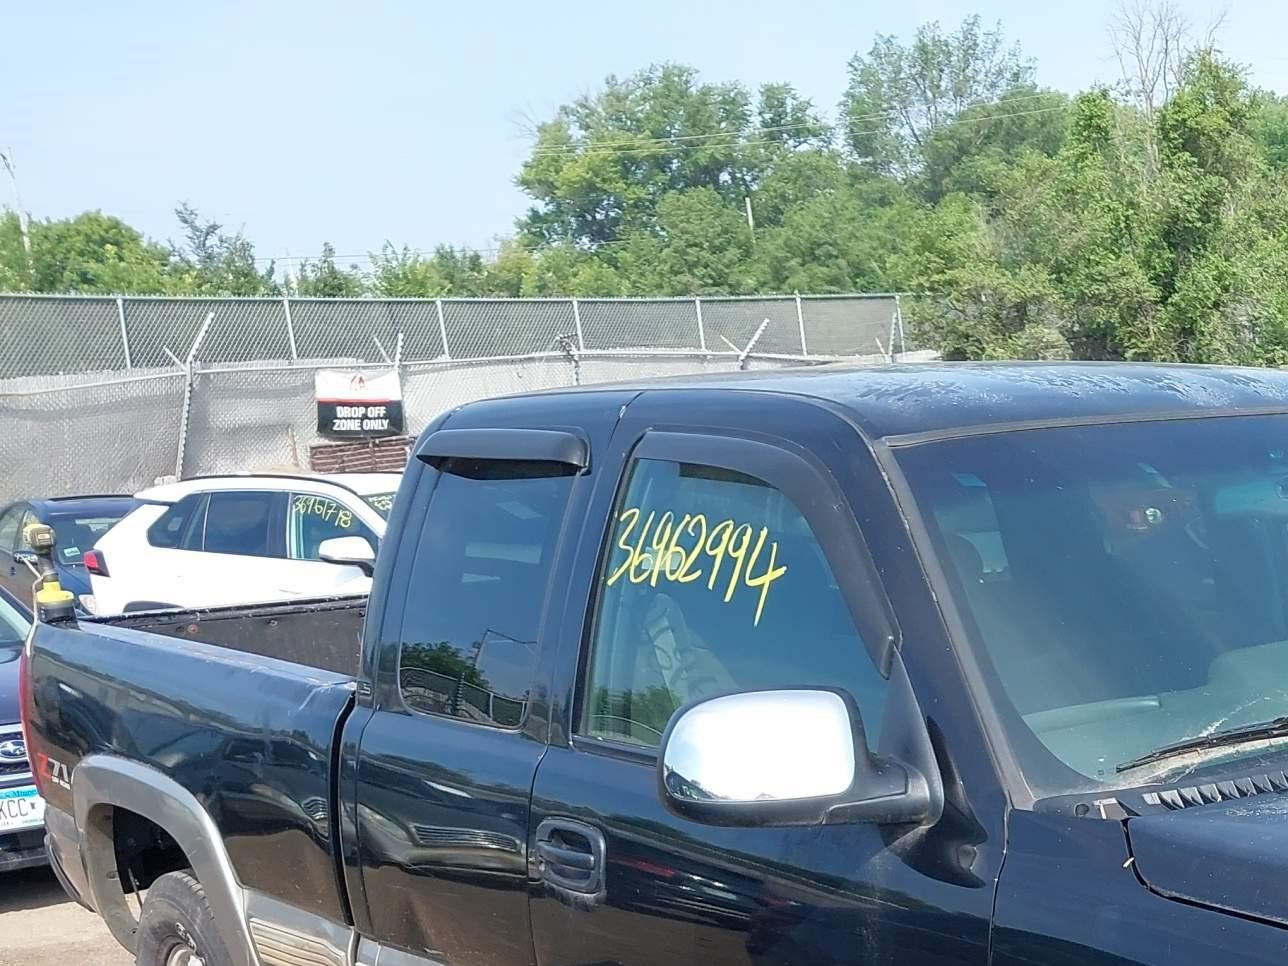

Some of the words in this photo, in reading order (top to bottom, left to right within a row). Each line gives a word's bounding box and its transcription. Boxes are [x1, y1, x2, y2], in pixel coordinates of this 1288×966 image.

[336, 406, 366, 418] DROP
[367, 406, 387, 418] OFF
[332, 419, 361, 431] ZONE
[362, 419, 389, 431] ONLY
[607, 508, 788, 627] 36962994
[37, 751, 69, 784] Z71
